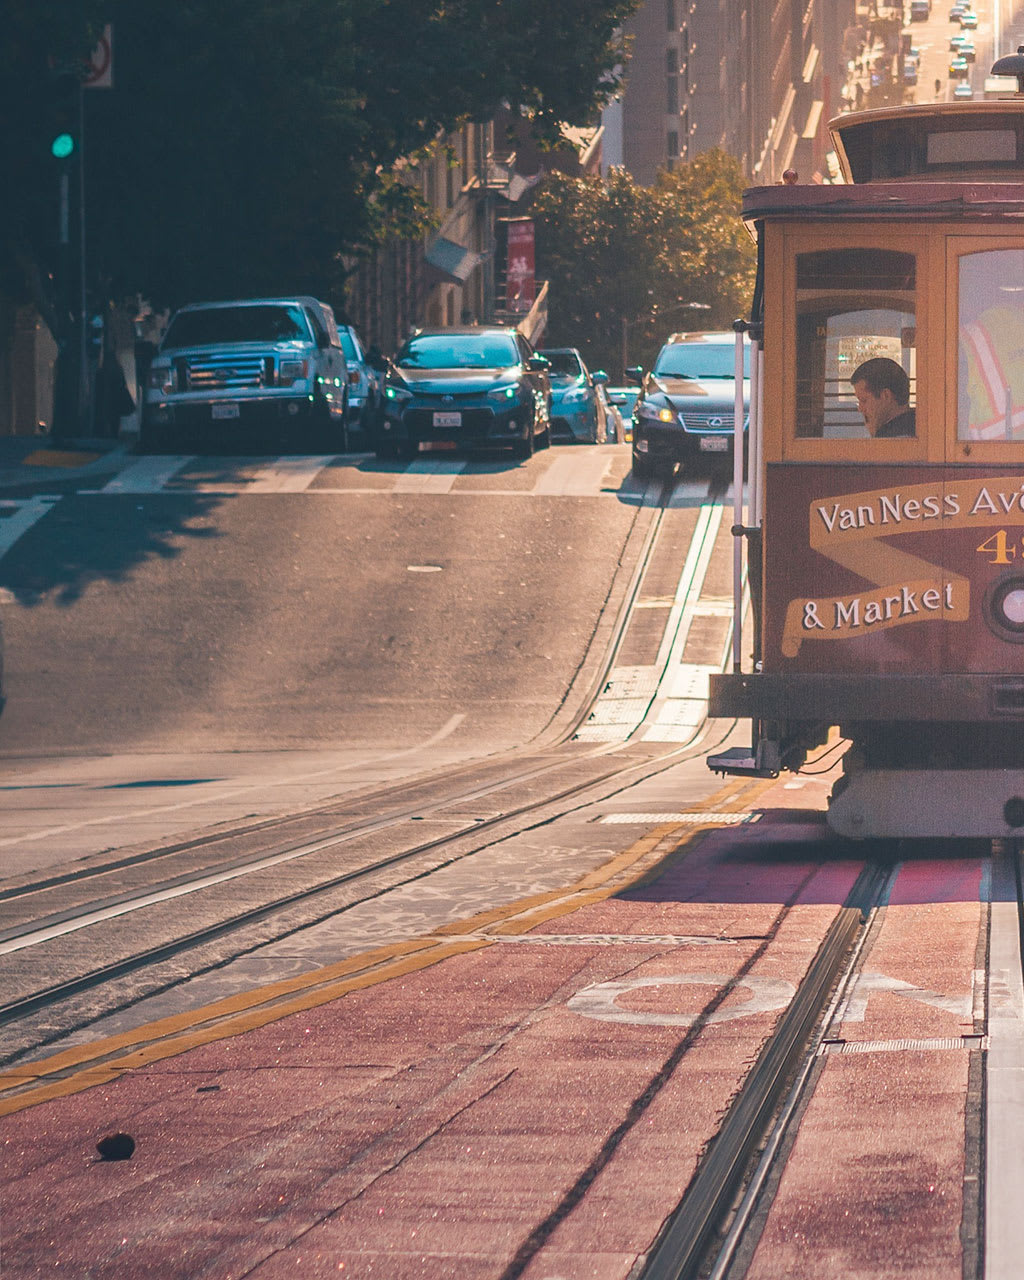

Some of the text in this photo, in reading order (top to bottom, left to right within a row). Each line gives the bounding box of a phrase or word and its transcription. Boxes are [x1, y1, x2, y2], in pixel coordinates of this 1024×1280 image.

[818, 504, 875, 534] Van
[880, 488, 961, 524] Ness
[802, 583, 955, 630] & Market
